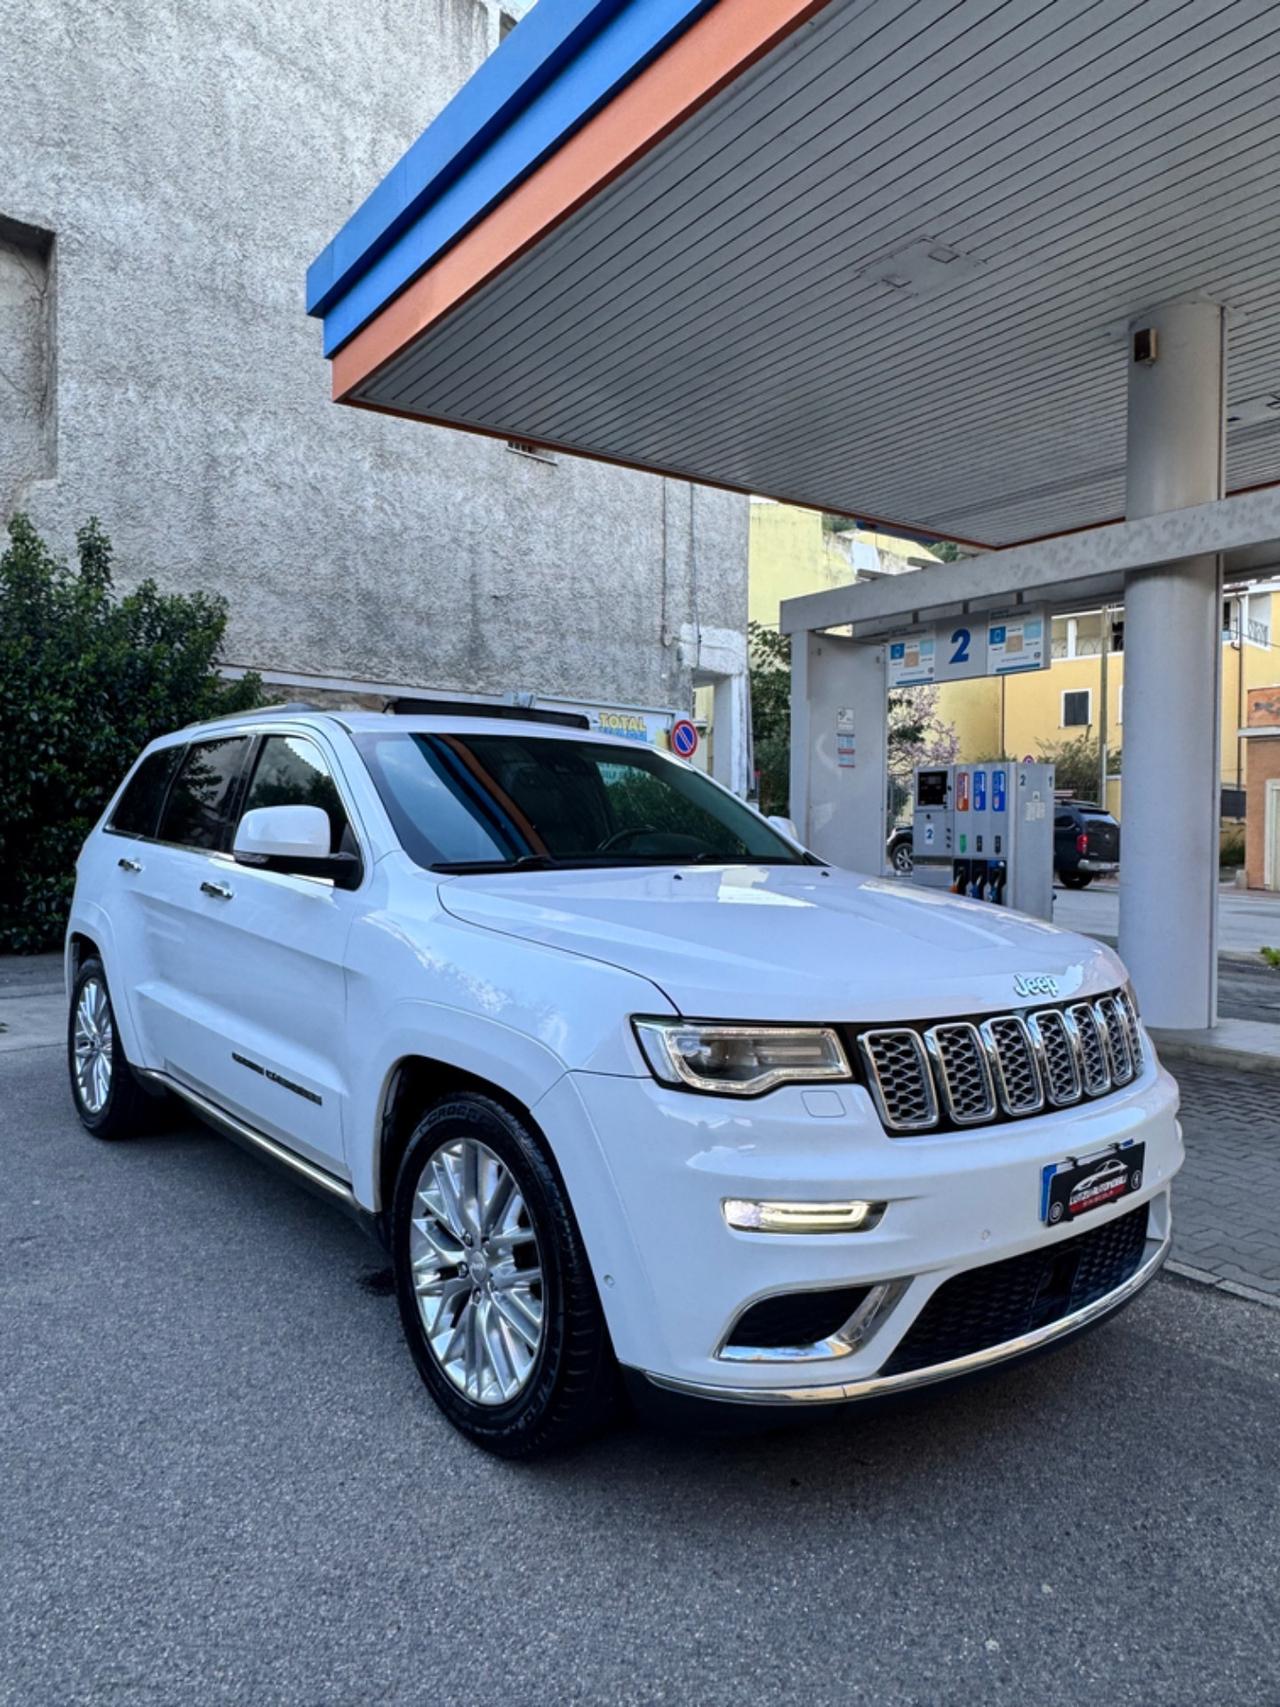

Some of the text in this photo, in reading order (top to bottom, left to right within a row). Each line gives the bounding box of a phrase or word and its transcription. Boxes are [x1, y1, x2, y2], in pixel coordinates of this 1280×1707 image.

[949, 628, 971, 664] 2
[599, 712, 647, 732] TOTAL
[1019, 774, 1026, 786] 2
[926, 828, 934, 840] 2
[1013, 973, 1059, 998] Jeep
